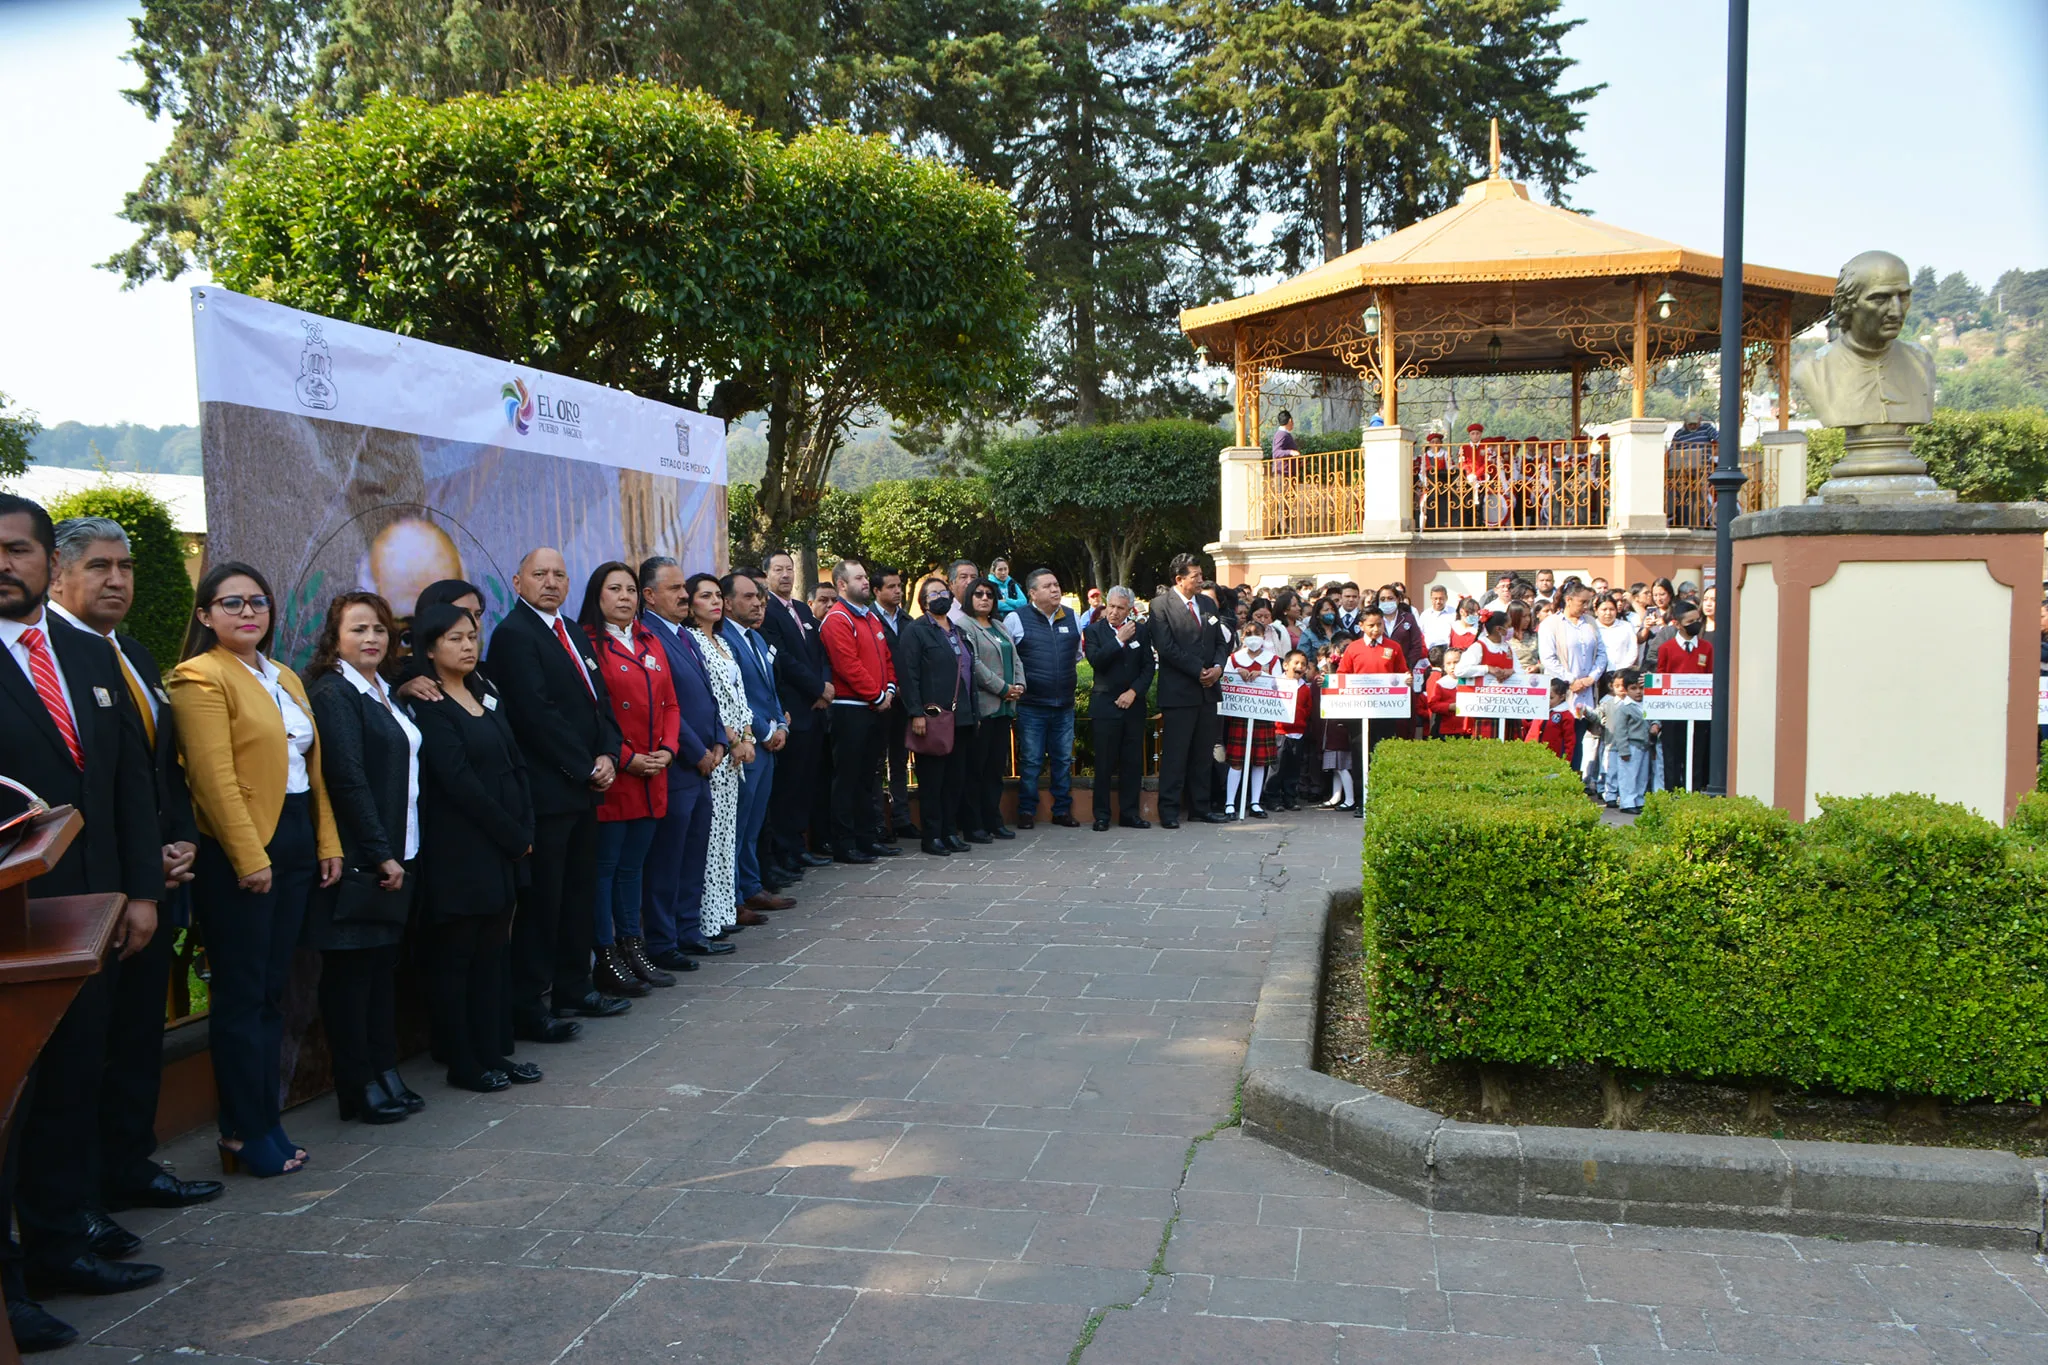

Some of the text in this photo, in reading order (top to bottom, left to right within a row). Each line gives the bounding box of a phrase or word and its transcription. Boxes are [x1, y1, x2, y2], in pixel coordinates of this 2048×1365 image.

[537, 394, 580, 424] EL ORO
[660, 457, 681, 470] ESTADO
[682, 461, 690, 471] DE
[1339, 687, 1390, 695] PREESCOLAR
[1475, 686, 1528, 695] PREESCOLAR
[1367, 700, 1378, 709] DE
[1379, 699, 1407, 709] MAYO"
[1476, 695, 1530, 706] "ESPERANZA
[1675, 700, 1703, 710] GARCÍA
[1221, 702, 1243, 711] LUISA
[1499, 704, 1511, 713] DE
[1511, 705, 1540, 715] VEGA"
